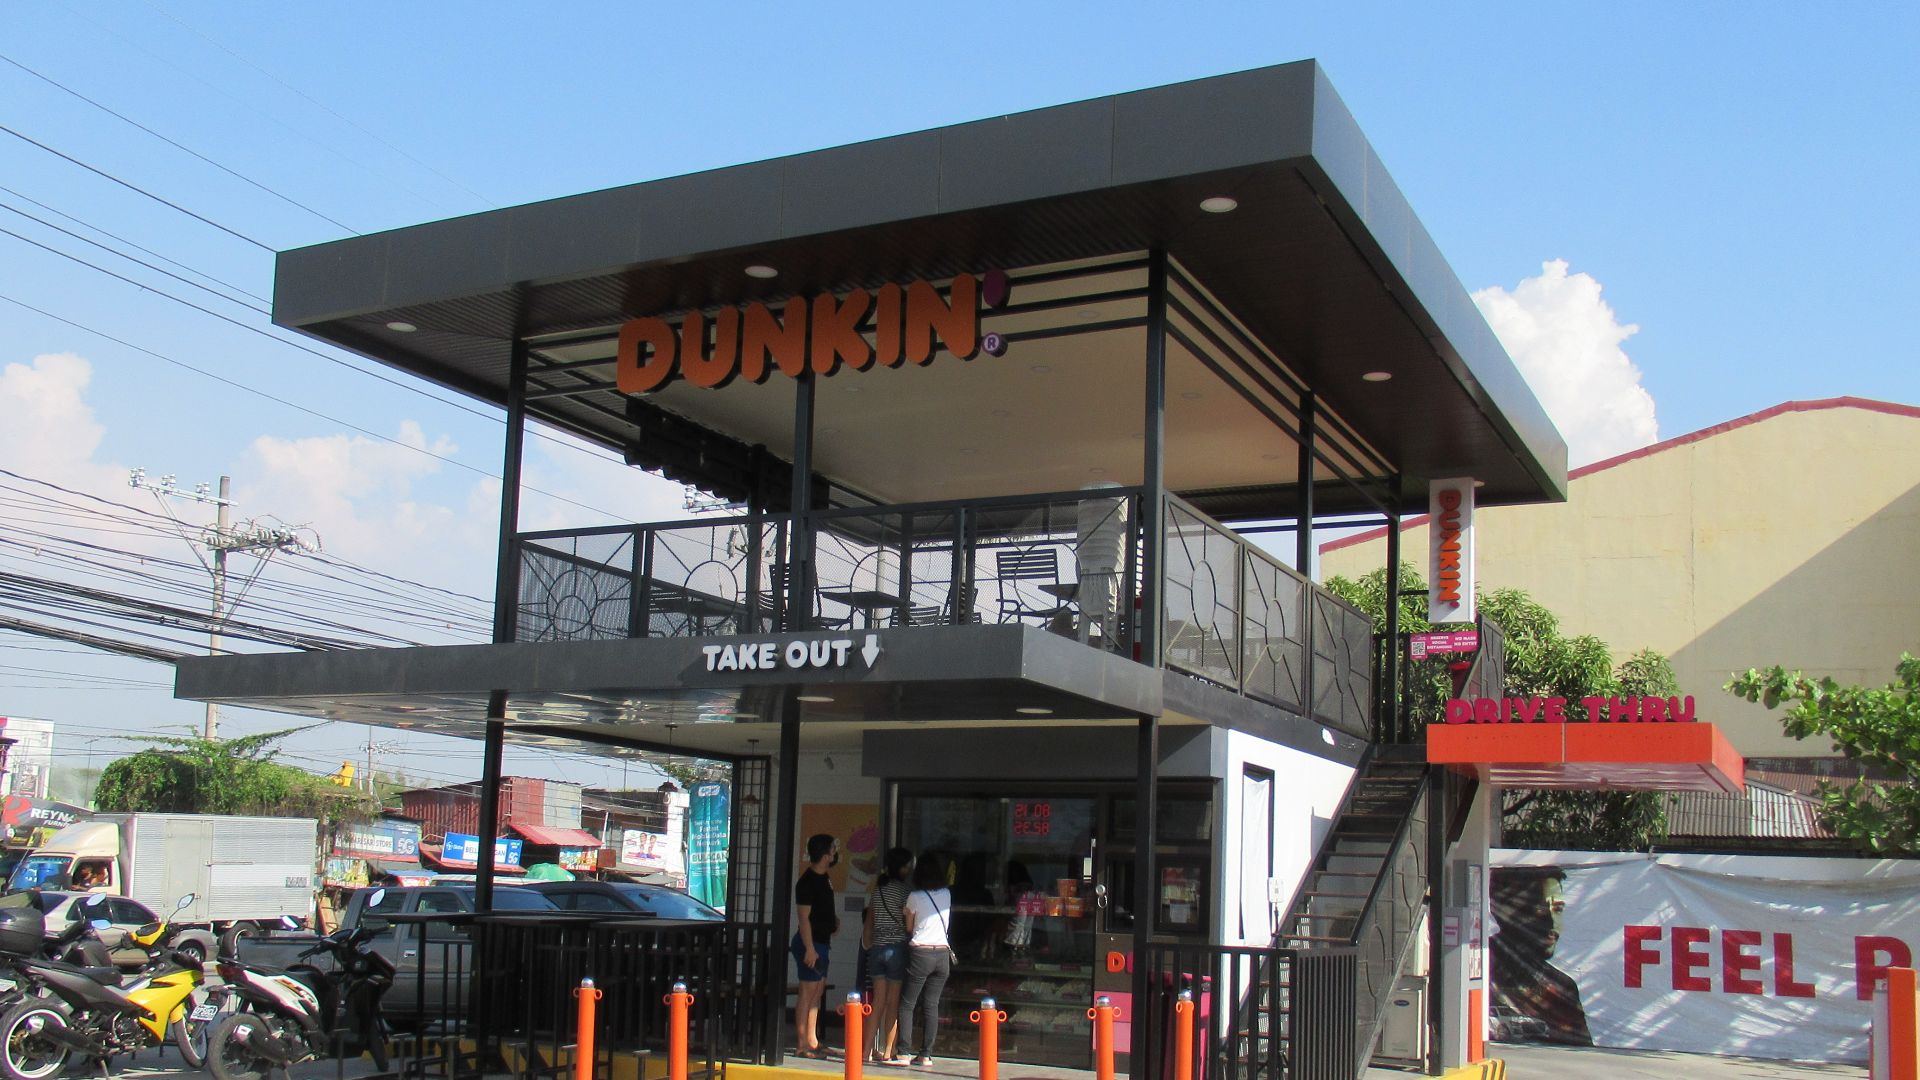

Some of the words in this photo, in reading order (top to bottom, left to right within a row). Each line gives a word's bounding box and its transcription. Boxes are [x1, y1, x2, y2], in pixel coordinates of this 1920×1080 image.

[616, 270, 1012, 394] DUNKIN'
[1438, 489, 1463, 608] DUNKIN'
[702, 642, 777, 672] TAKE
[785, 639, 852, 669] OUT
[1445, 697, 1567, 725] DRIVE
[1581, 695, 1696, 724] THRU
[43, 820, 69, 828] FURNI
[1623, 925, 1816, 998] FEEL
